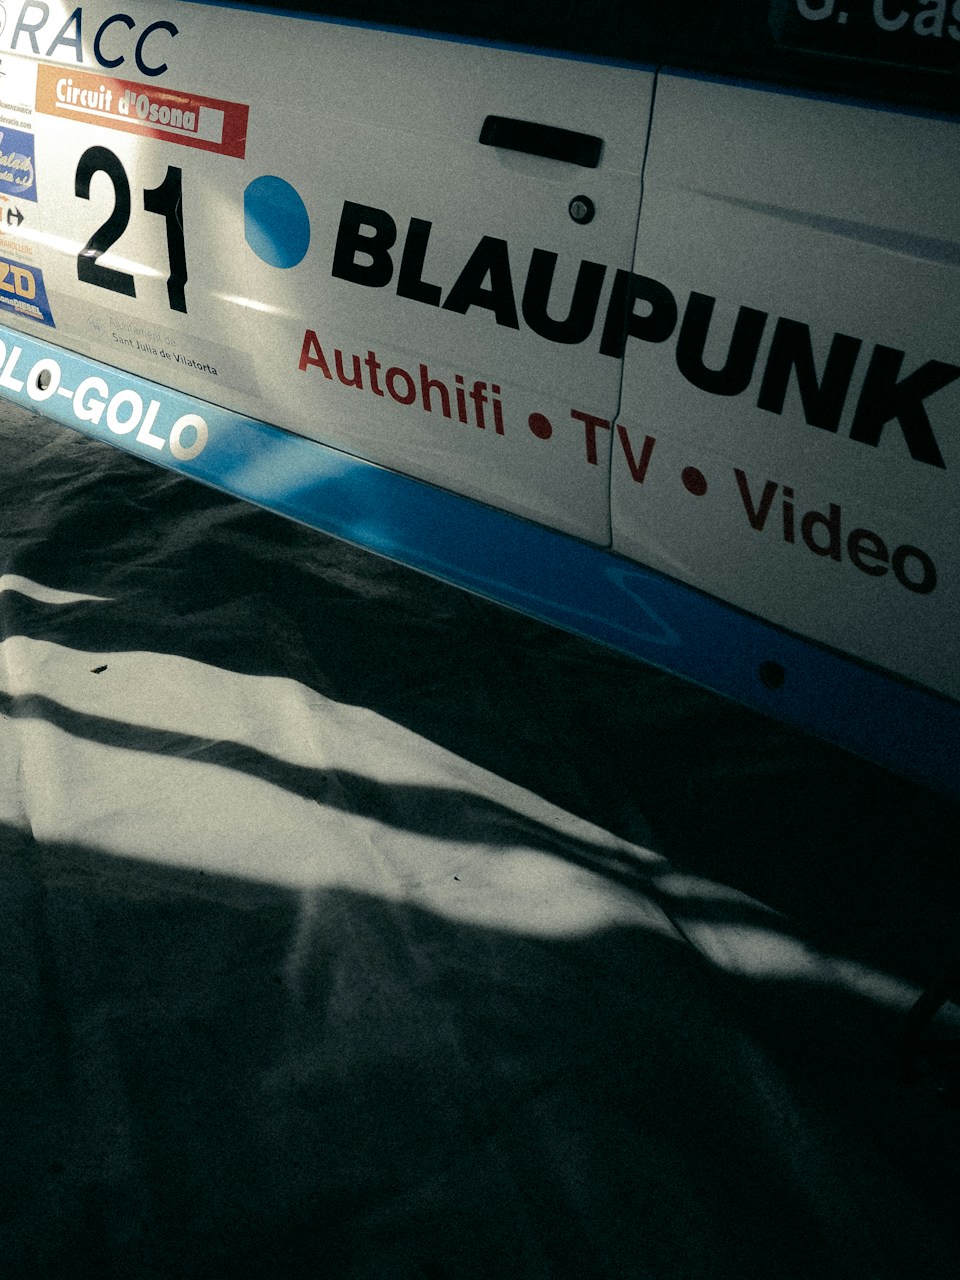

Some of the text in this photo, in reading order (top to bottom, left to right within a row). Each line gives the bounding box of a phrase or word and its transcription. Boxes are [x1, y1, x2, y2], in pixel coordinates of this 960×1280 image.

[10, 0, 178, 77] RACC
[55, 77, 196, 131] Circuit d'Osona
[75, 146, 188, 314] 21
[111, 332, 134, 349] Sant
[173, 352, 219, 377] Vilatorta
[297, 328, 938, 596] Autohifi TV Video
